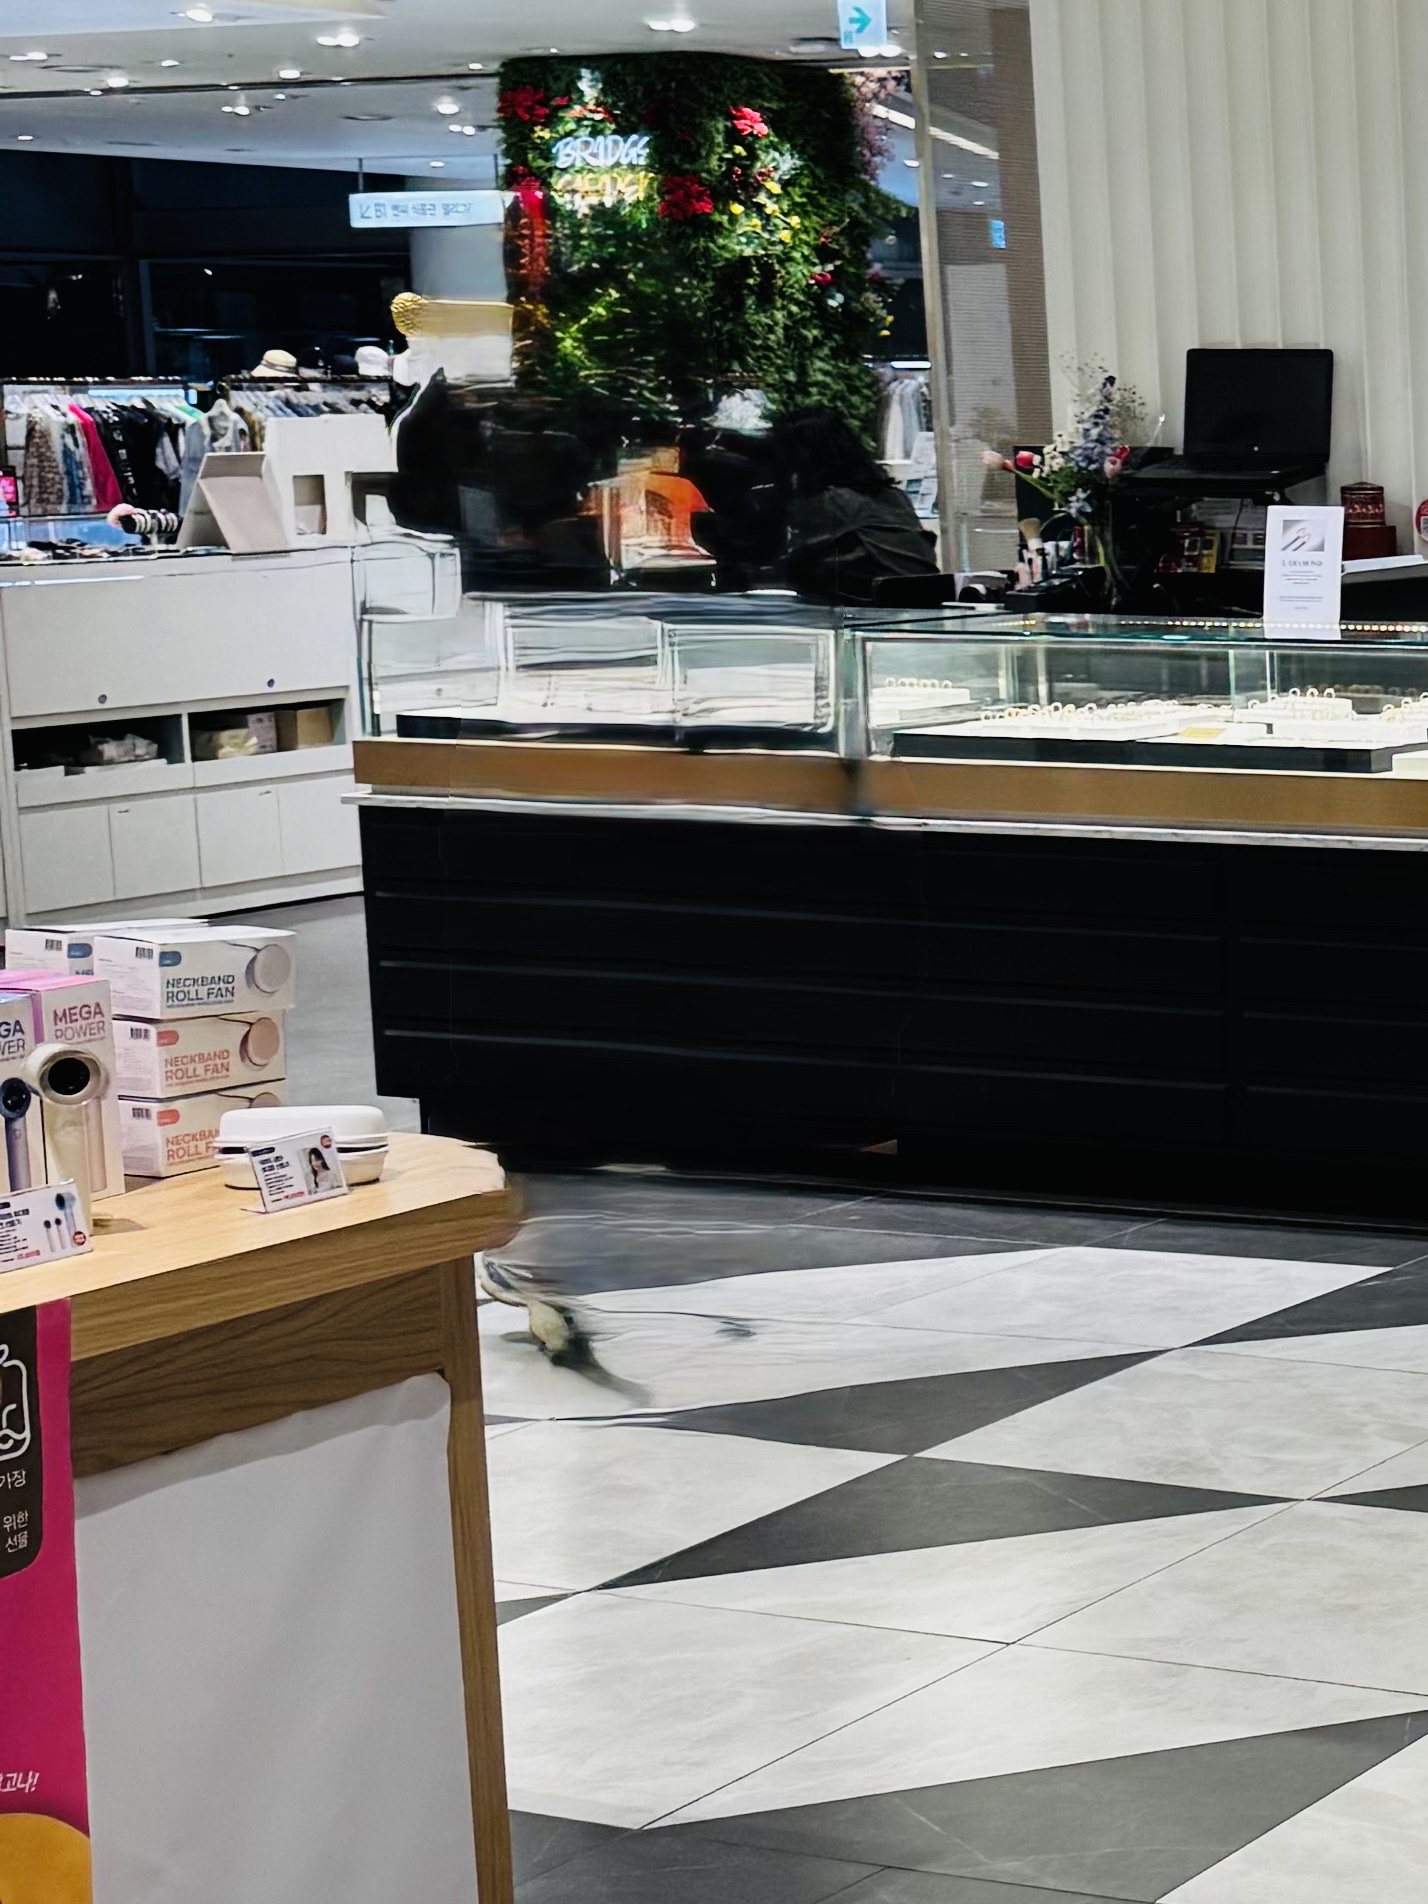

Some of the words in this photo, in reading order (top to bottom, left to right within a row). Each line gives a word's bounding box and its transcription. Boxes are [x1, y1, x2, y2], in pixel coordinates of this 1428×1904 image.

[166, 974, 236, 989] NECKBAND
[166, 988, 204, 1003] ROLL
[207, 984, 235, 1000] FAN
[53, 1001, 105, 1026] MEGA
[54, 1023, 106, 1041] POWER
[164, 1049, 231, 1069] NECKBAND
[165, 1065, 202, 1082] ROLL
[204, 1061, 231, 1077] FAN
[165, 1128, 220, 1149] NECKBAN
[166, 1144, 203, 1162] ROLL
[0, 1469, 27, 1490] 가장
[3, 1510, 29, 1533] 위한
[5, 1530, 29, 1553] 선물
